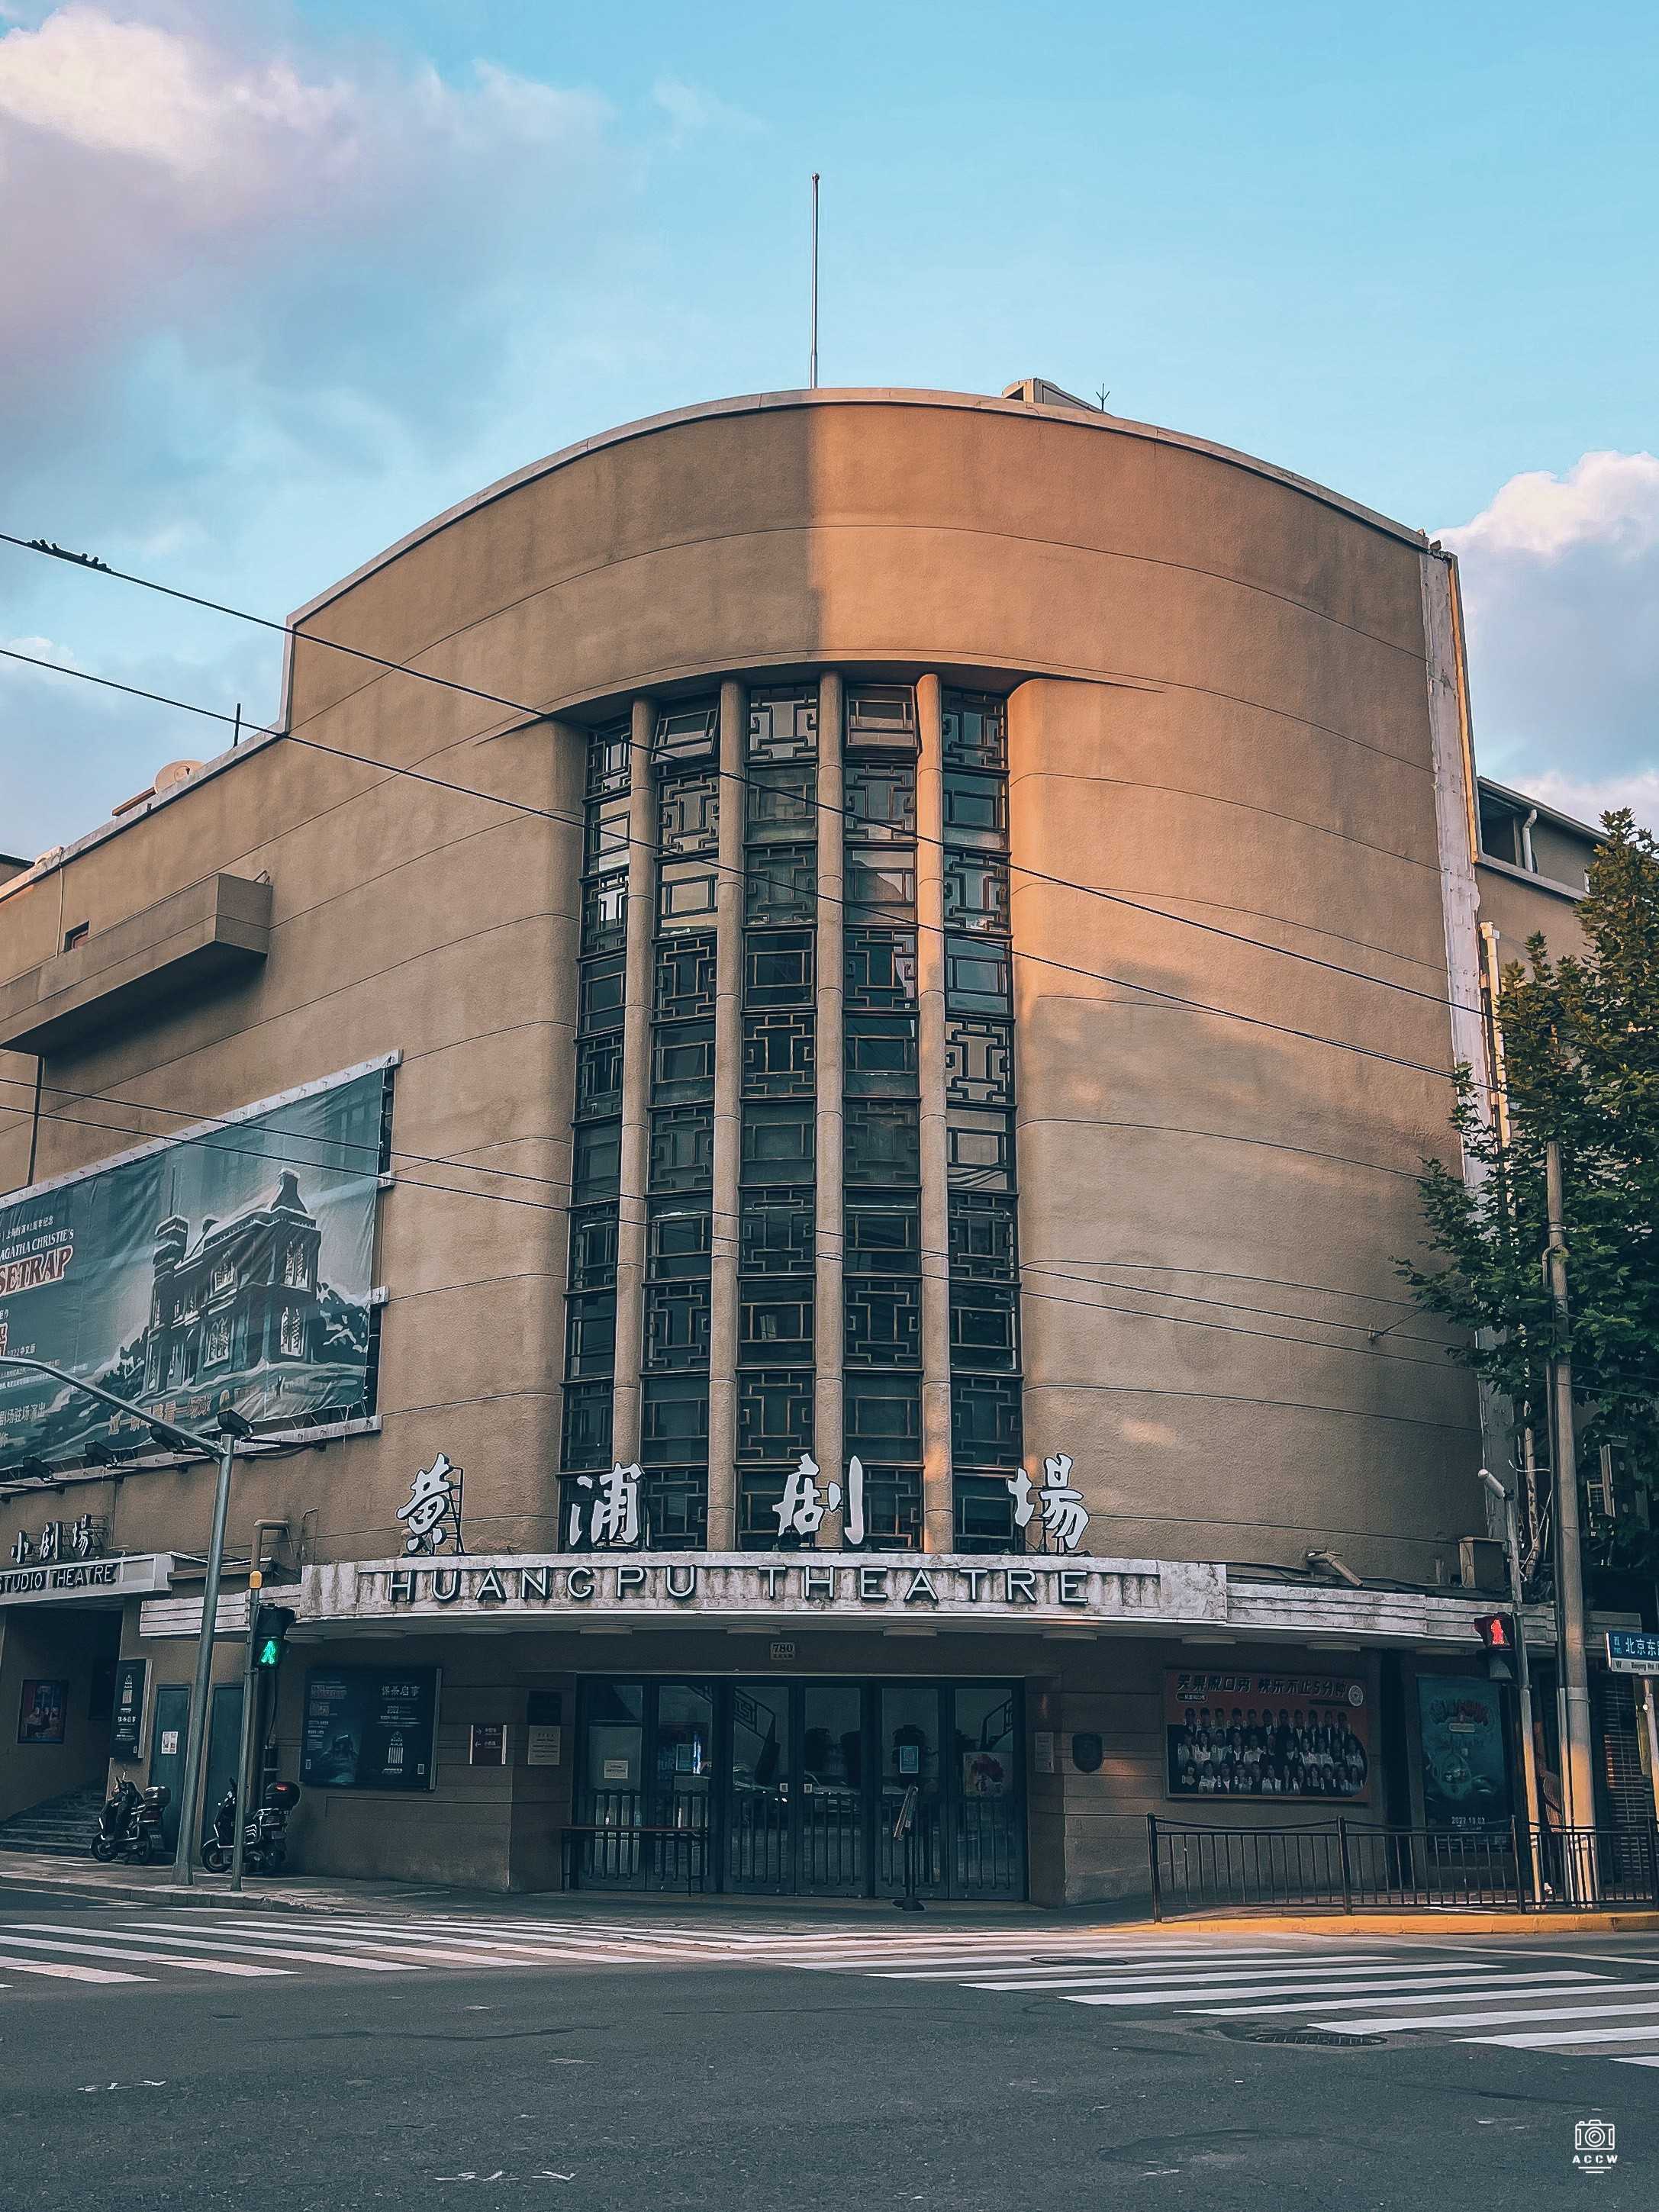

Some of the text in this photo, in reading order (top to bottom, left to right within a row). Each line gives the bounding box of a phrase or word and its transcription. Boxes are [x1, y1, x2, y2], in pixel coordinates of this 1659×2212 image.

[31, 1227, 74, 1251] CHRISTIE'S
[50, 1564, 114, 1589] THEATRE
[389, 1565, 1089, 1605] HUANGPU THEATRE
[773, 1643, 794, 1653] 780
